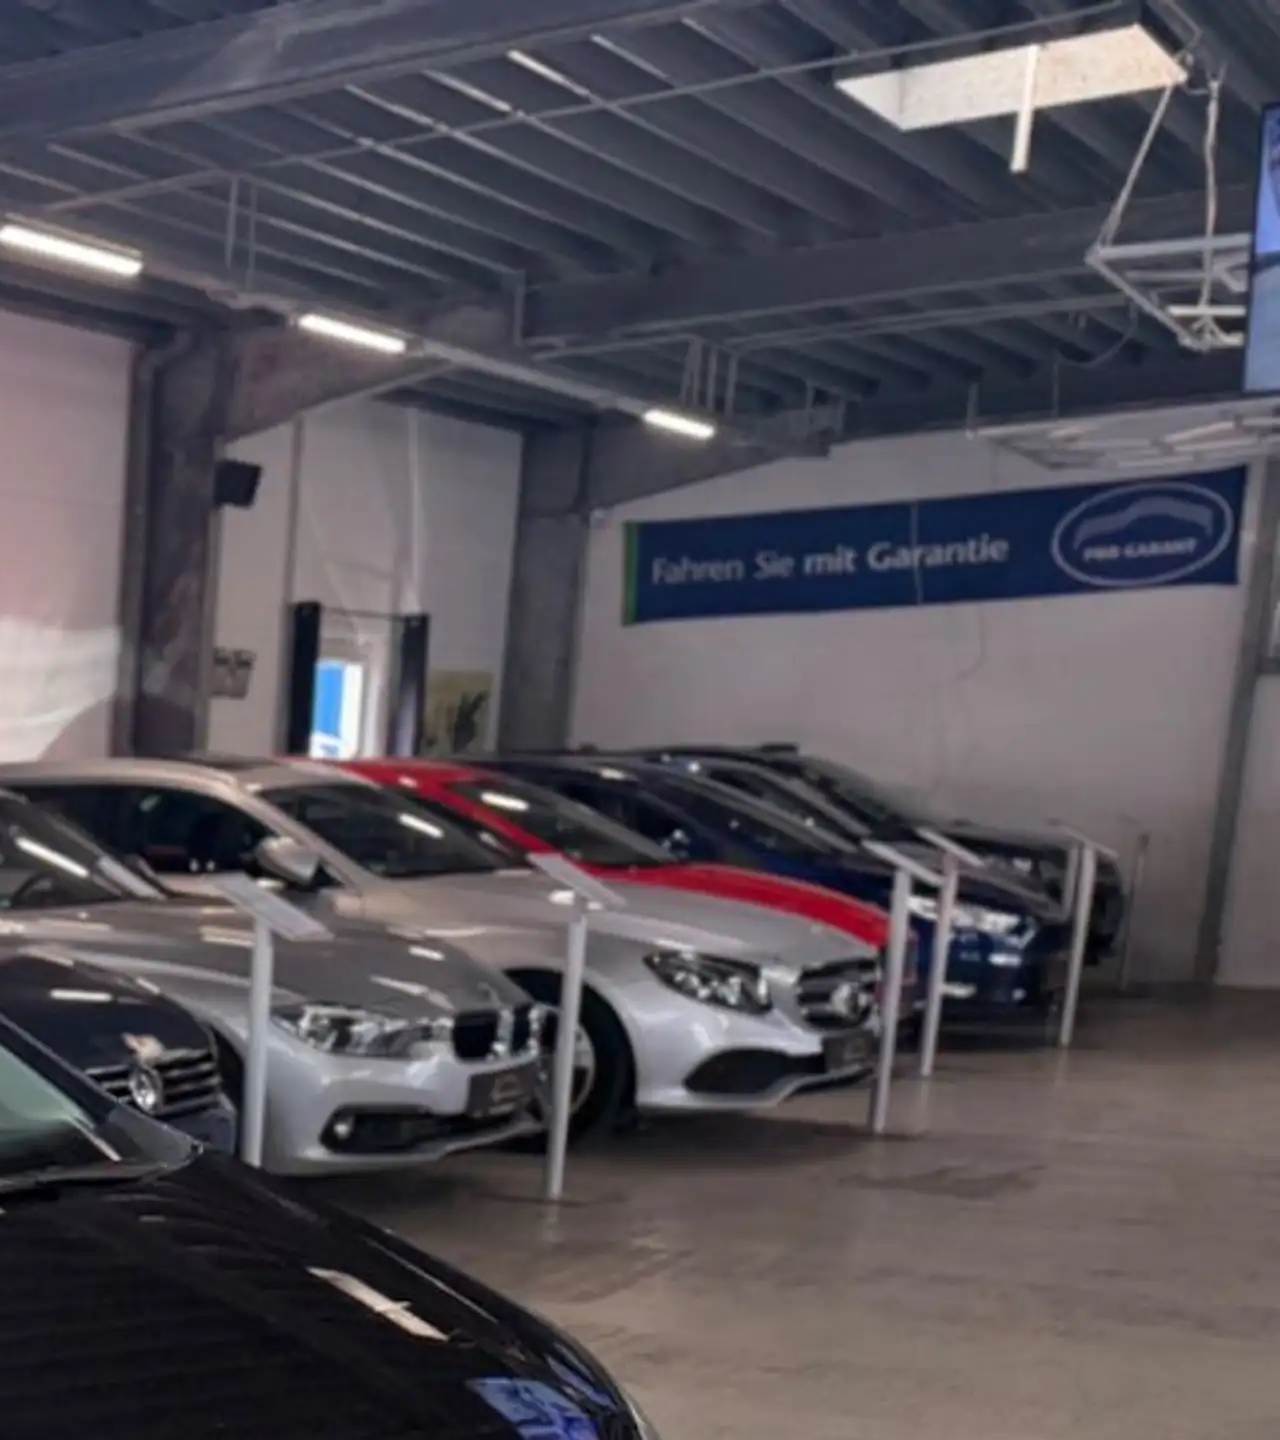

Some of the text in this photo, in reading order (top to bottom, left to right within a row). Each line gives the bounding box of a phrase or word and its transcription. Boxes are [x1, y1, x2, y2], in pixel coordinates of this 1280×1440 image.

[651, 532, 1011, 585] Fahren Sie mit Garantie
